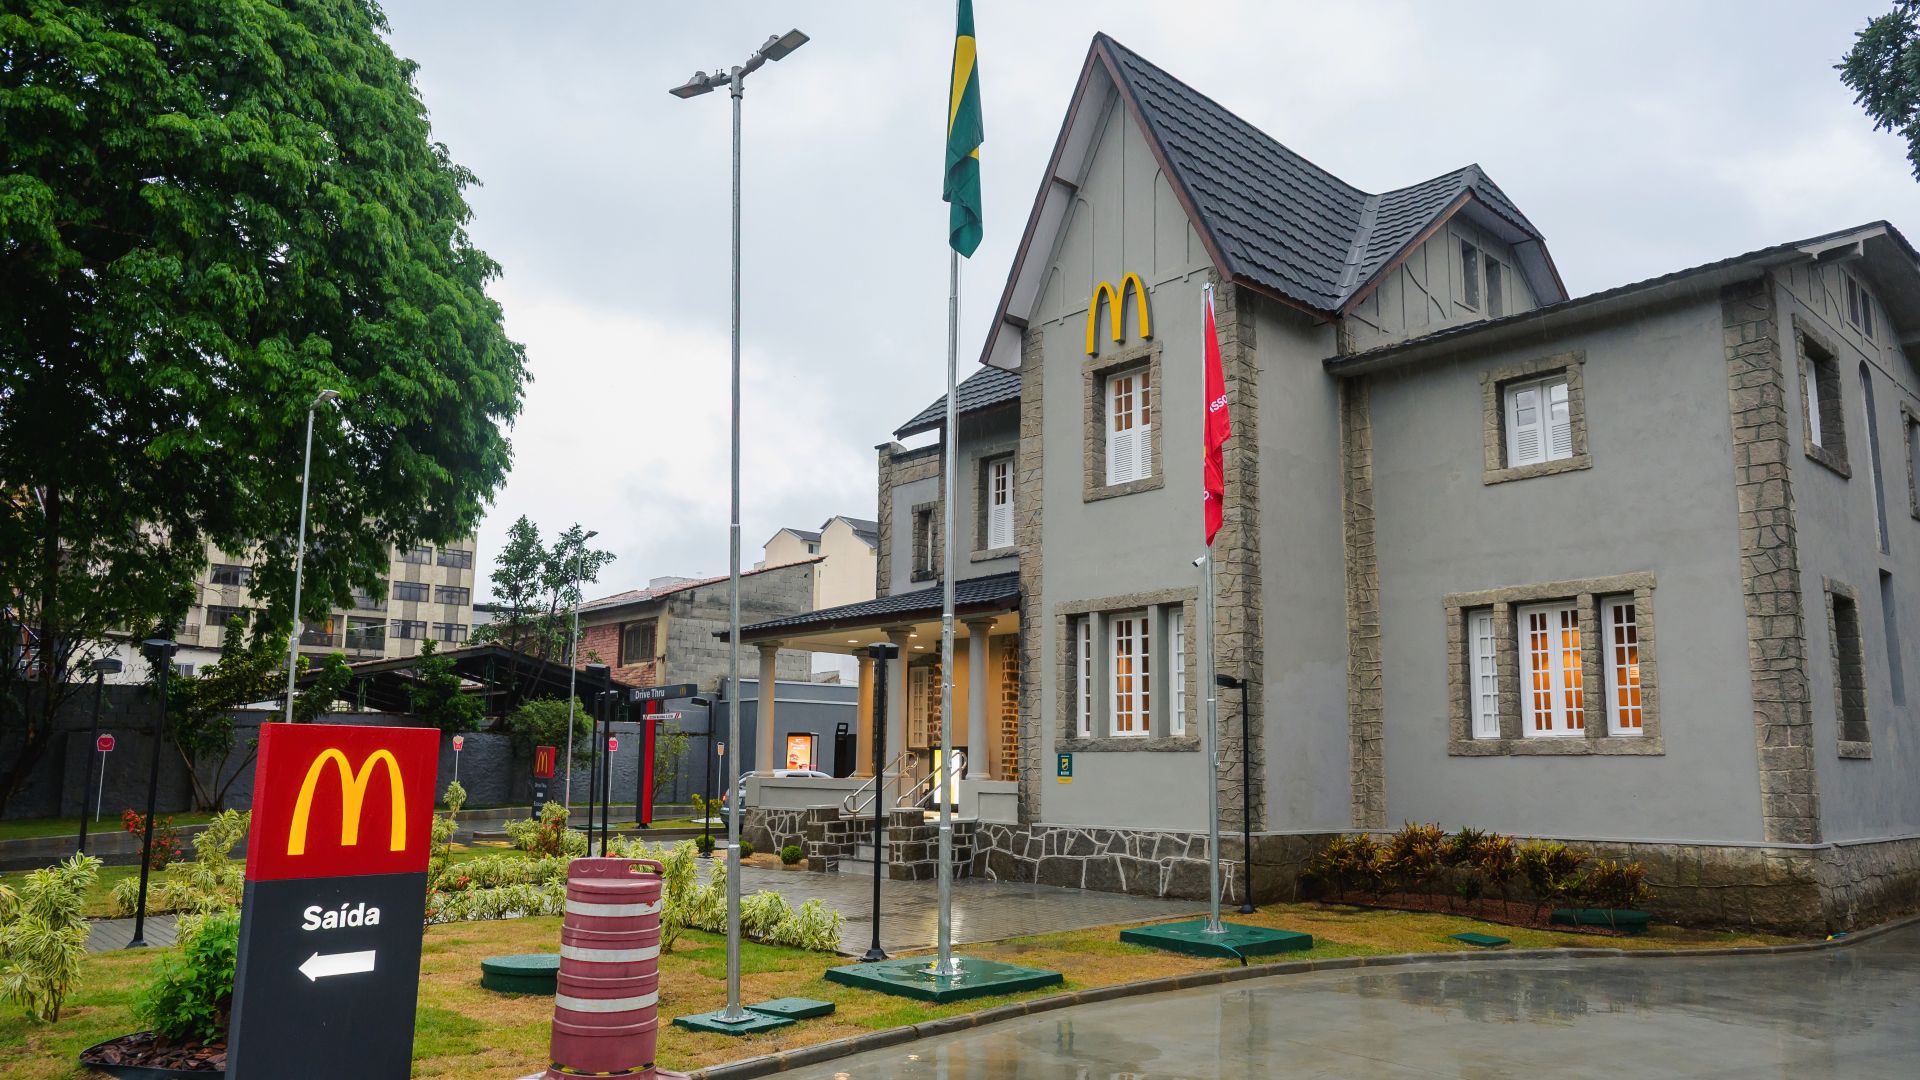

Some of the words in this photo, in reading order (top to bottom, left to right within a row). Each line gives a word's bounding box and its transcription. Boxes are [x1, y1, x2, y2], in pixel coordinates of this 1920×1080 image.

[635, 690, 650, 699] Drive
[651, 688, 665, 697] Thru
[302, 903, 380, 931] Saída
